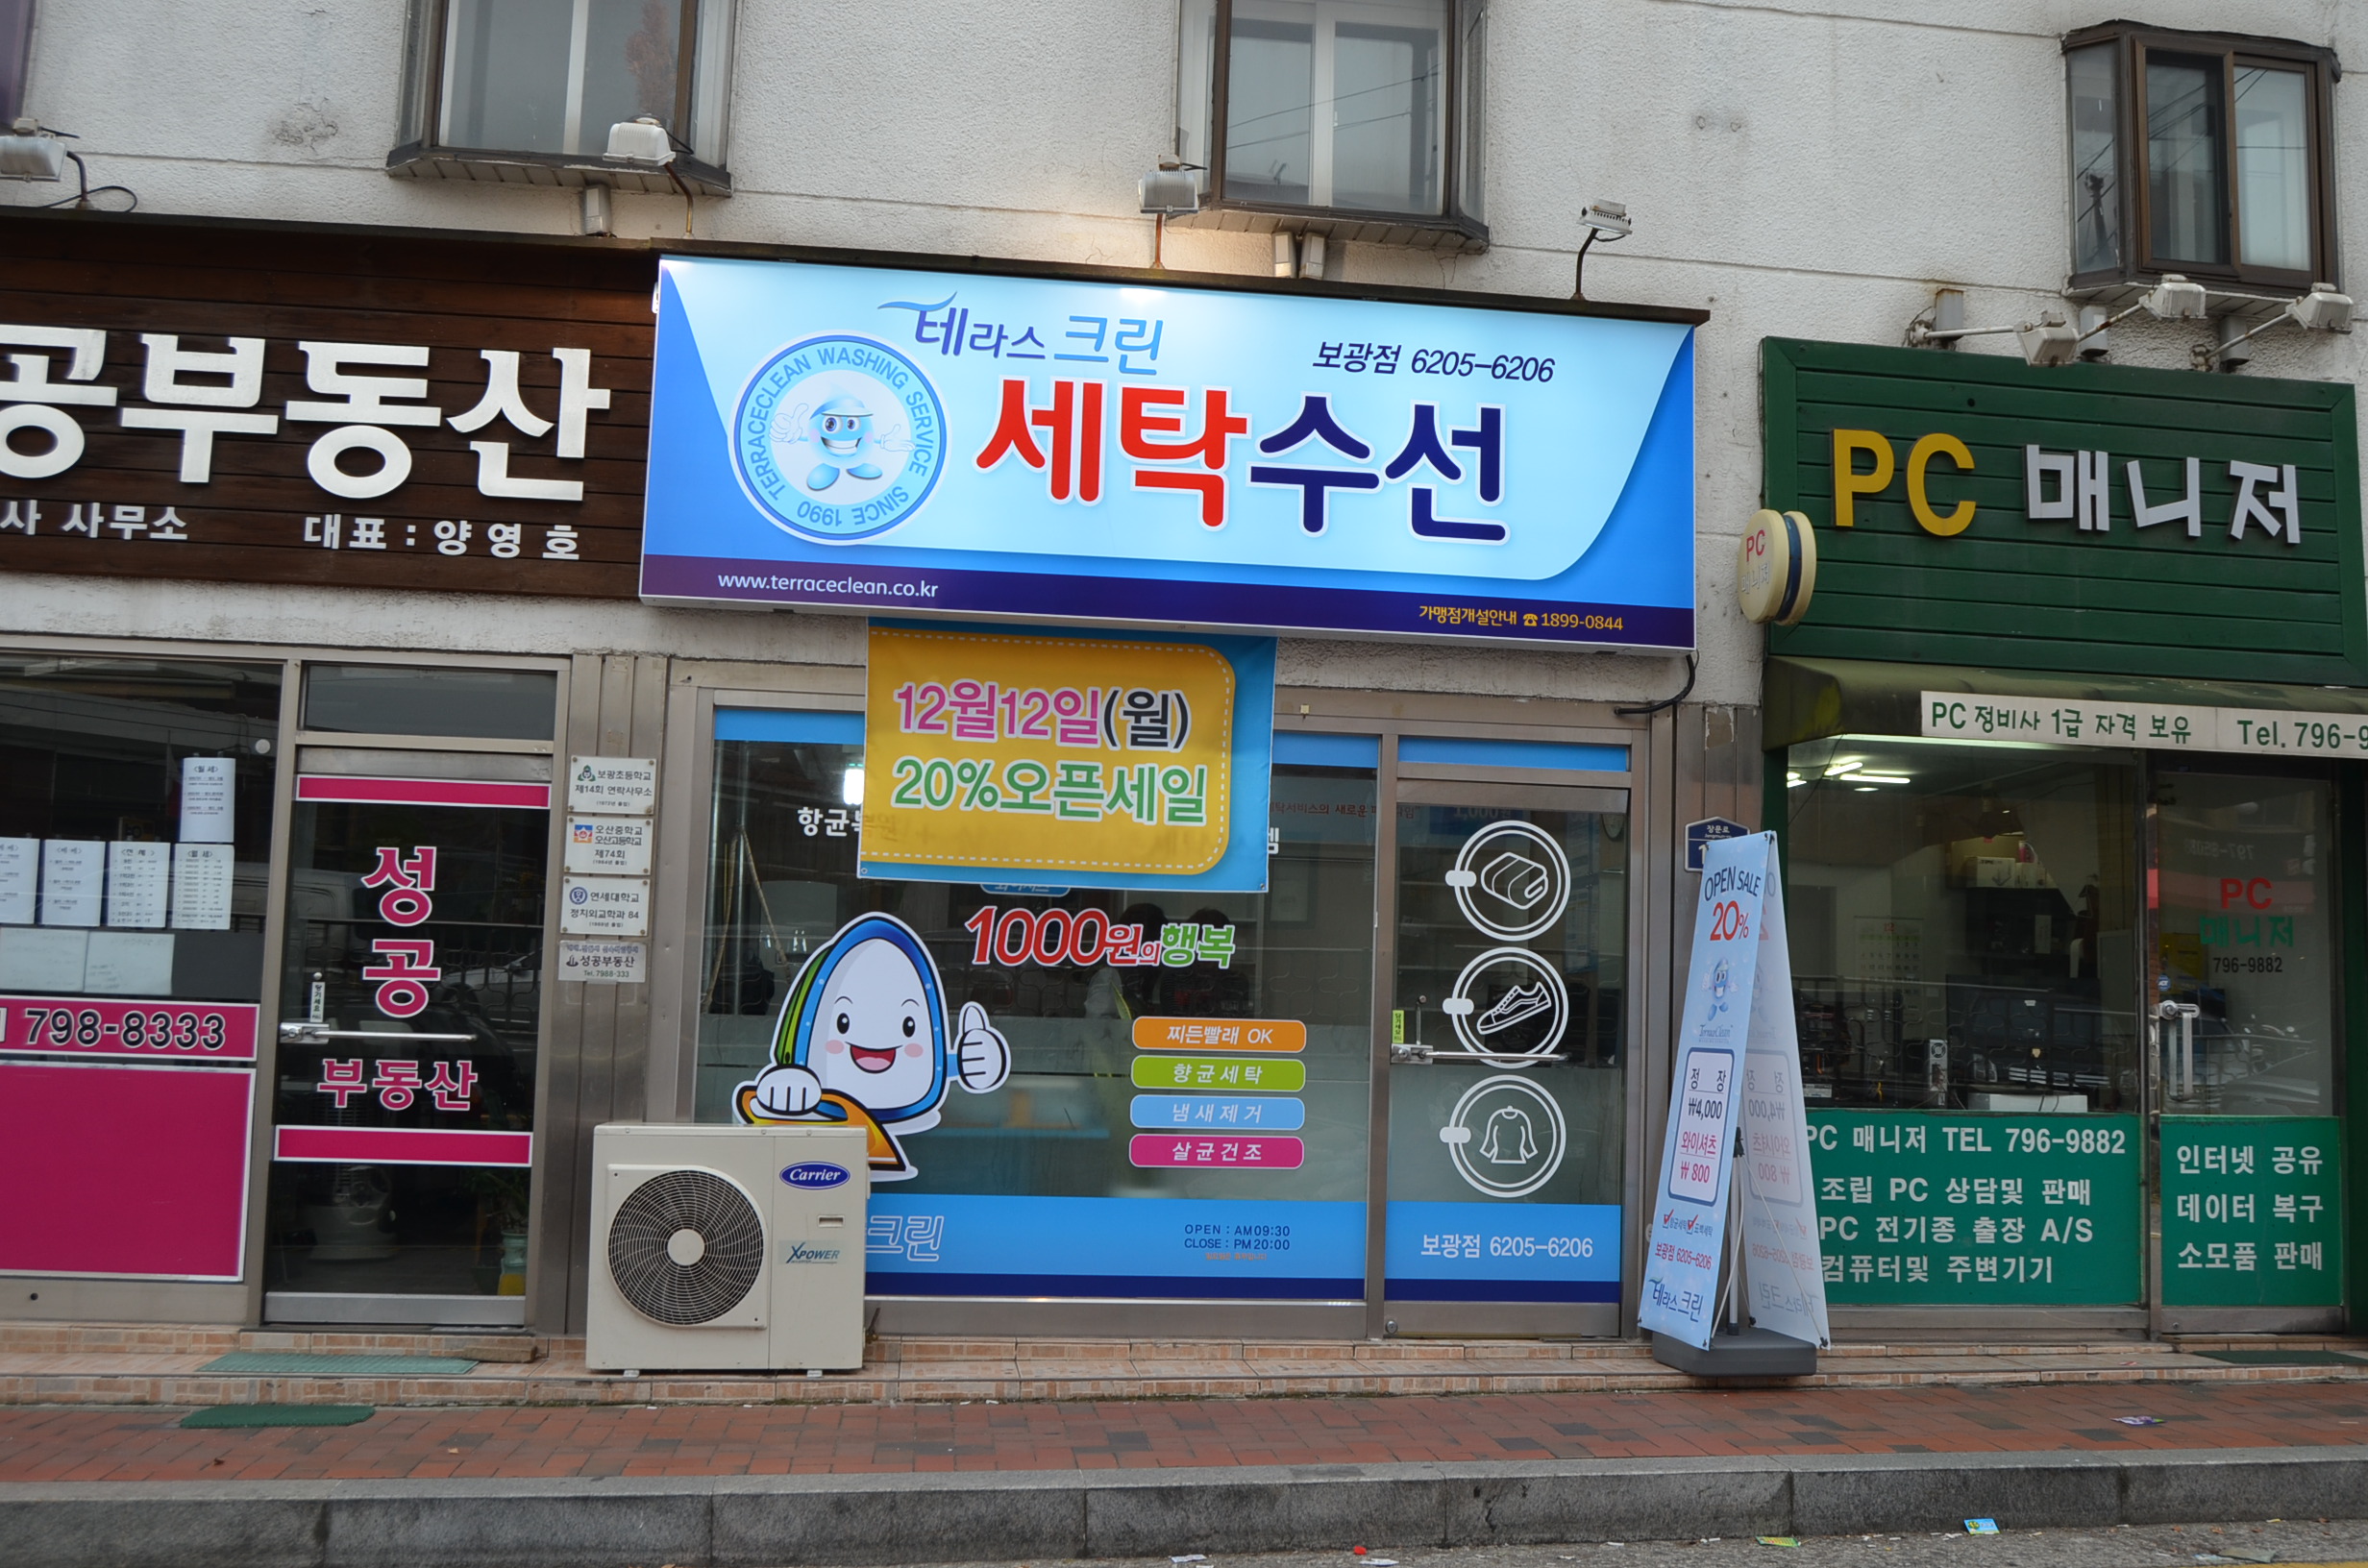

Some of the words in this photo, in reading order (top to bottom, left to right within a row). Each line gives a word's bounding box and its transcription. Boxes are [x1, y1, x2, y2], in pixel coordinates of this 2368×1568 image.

[1313, 341, 1401, 375] 보광점
[1411, 348, 1555, 382] 6205-6206
[748, 355, 812, 501] TERRACECLEAN
[817, 347, 909, 389] WASHING
[905, 390, 934, 478] SERVICE
[1830, 429, 1977, 537] PC
[2024, 444, 2302, 544] 매니저
[797, 501, 842, 527] 1990
[851, 485, 909, 526] SINCE
[62, 502, 188, 540] 사무소
[1746, 529, 1765, 562] PC
[718, 571, 938, 599] www.terraceclean.co.kr
[1419, 605, 1517, 626] 가맹점개설안내
[1541, 612, 1624, 630] 1899-0844
[1931, 701, 1966, 730] PC
[1974, 704, 2041, 734] 정비사
[2052, 708, 2084, 739] 1급
[2095, 713, 2136, 742] 자격
[2150, 715, 2192, 746] 보유
[598, 771, 652, 780] 보광초등학교
[607, 786, 653, 796] 연락사무소
[596, 825, 643, 835] 오산중학교
[1706, 824, 1731, 834] 장문로
[590, 892, 639, 902] 연세대학교
[1704, 866, 1737, 901] OPEN
[1737, 870, 1762, 897] SALE
[2220, 877, 2273, 910] PC
[570, 909, 626, 919] 정치외교학과
[1710, 900, 1749, 942] 20%
[2199, 915, 2294, 947] 매니저
[580, 955, 635, 968] 성공부동산
[2213, 957, 2283, 973] 796-9882
[25, 1008, 226, 1051] 798-8333
[1167, 1024, 1240, 1044] 찌든빨래
[1247, 1028, 1273, 1044] OK
[316, 1058, 479, 1111] 부동산
[1681, 1131, 1717, 1156] 와이셔츠
[1853, 1124, 1926, 1153] 매니저
[1942, 1127, 1991, 1152] TEL
[2005, 1128, 2126, 1154] 796-9882
[789, 1168, 842, 1181] Carrier
[2177, 1144, 2255, 1175] 인터넷
[2272, 1146, 2323, 1175] 공유
[1821, 1176, 1873, 1203] 조립
[1889, 1178, 1929, 1202] PC
[1945, 1178, 2023, 1204] 상담및
[2041, 1179, 2091, 1206] 판매
[2177, 1193, 2255, 1223] 데이터
[2272, 1194, 2324, 1223] 복구
[1819, 1216, 1859, 1240] PC
[1876, 1216, 1957, 1243] 전기종
[1972, 1216, 2025, 1243] 출장
[2040, 1216, 2093, 1243] A/S
[1420, 1233, 1481, 1259] 보광점
[1489, 1234, 1593, 1259] 6205-6206
[1655, 1241, 1675, 1262] 보광점
[1676, 1247, 1713, 1271] 6205-6206
[2178, 1242, 2257, 1271] 소모품
[2274, 1241, 2323, 1271] 판매
[1822, 1255, 1929, 1283] 컴퓨터및
[1947, 1256, 2053, 1283] 주변기기
